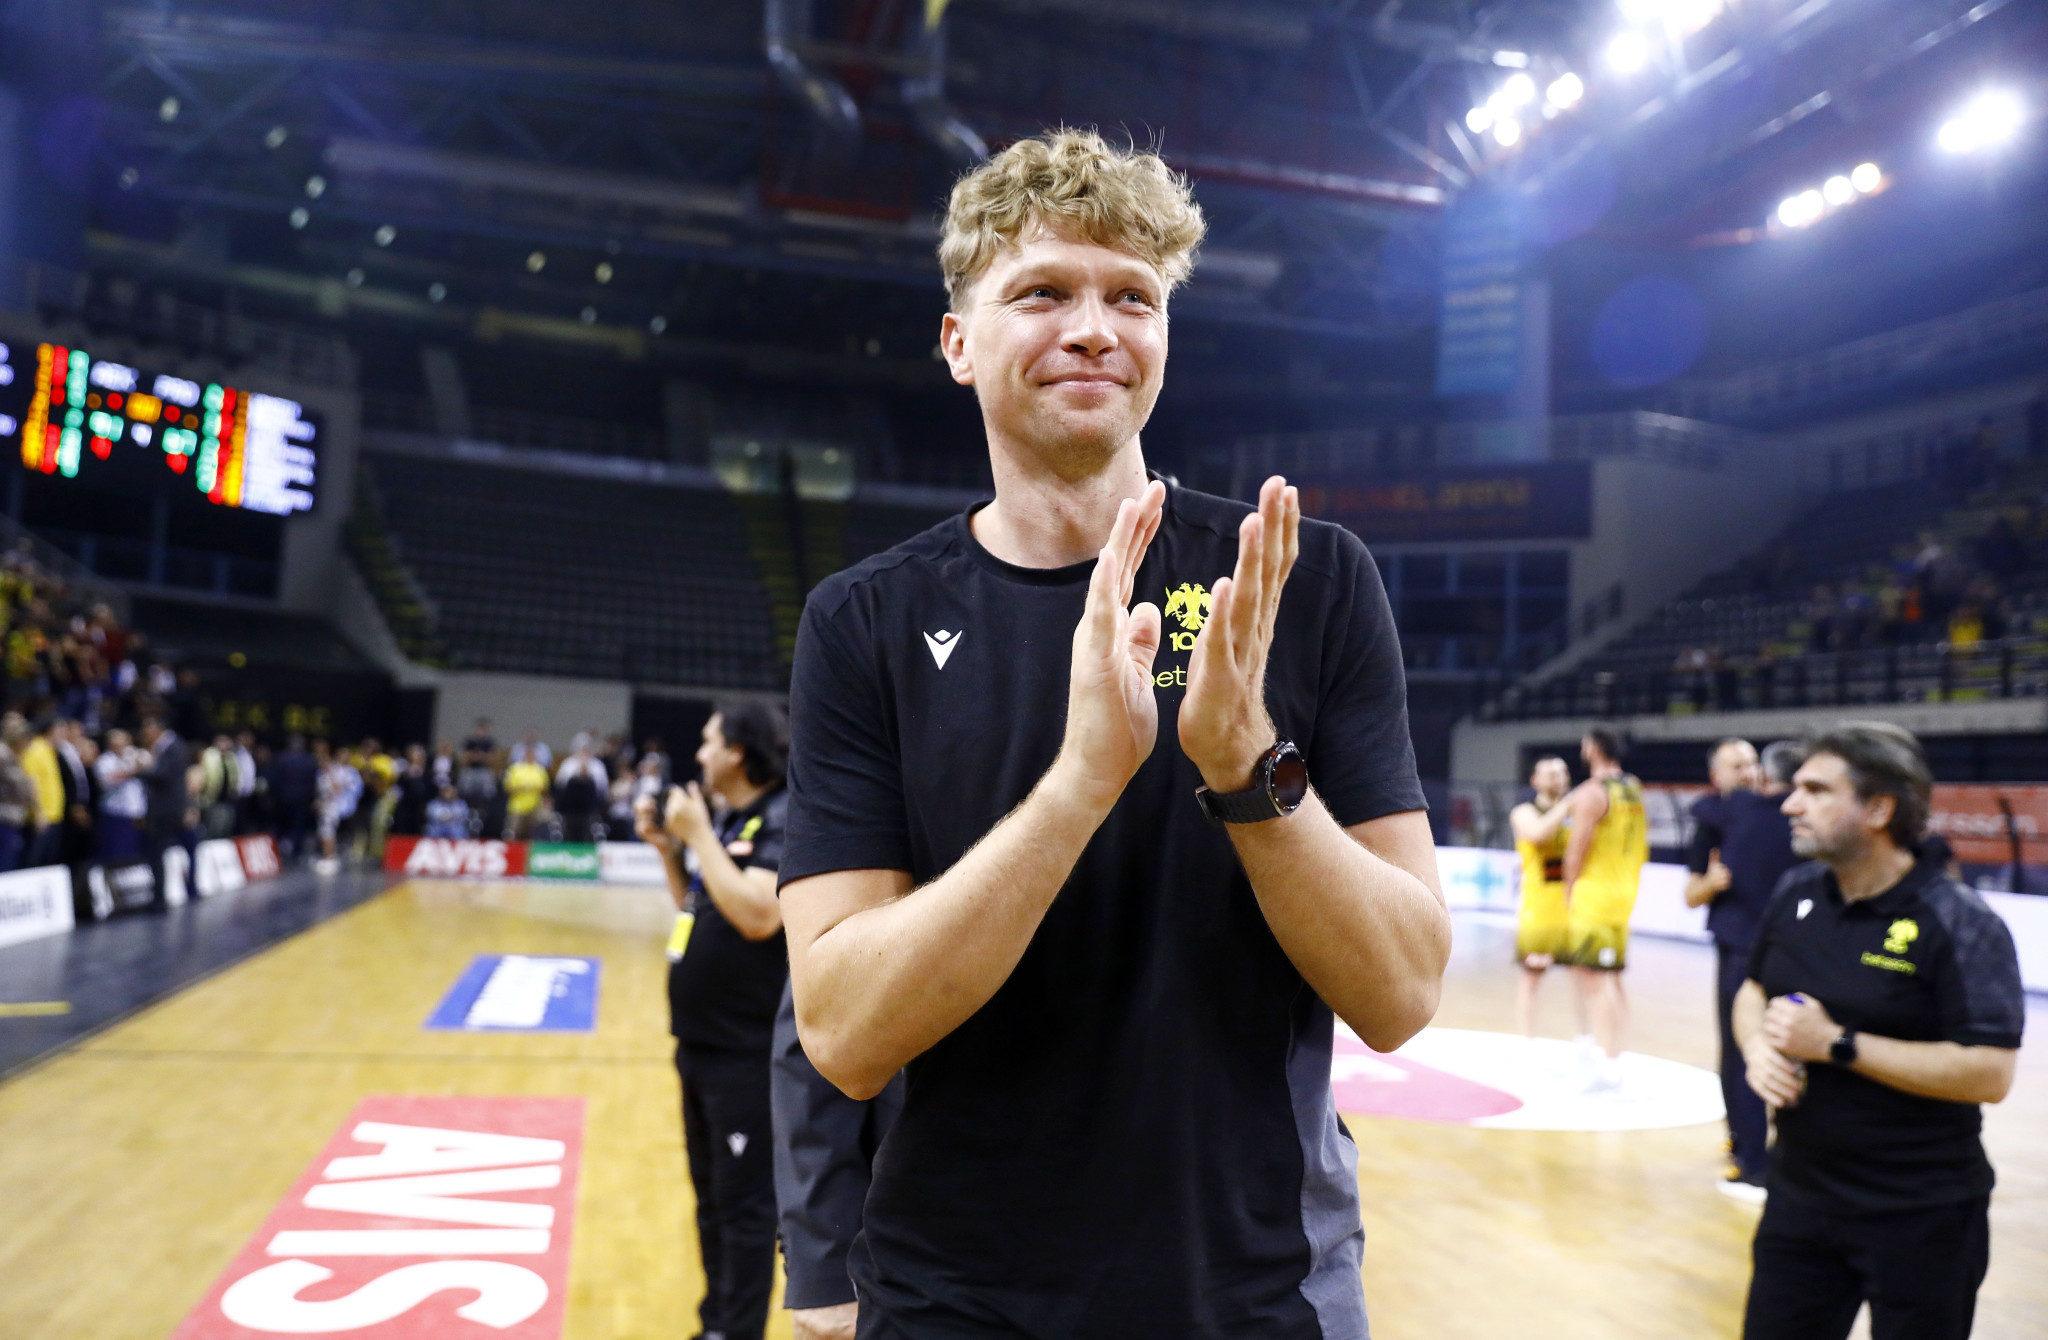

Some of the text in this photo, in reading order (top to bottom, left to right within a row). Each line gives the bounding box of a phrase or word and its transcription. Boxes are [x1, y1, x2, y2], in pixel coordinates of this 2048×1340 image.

[1151, 664, 1187, 688] et
[404, 838, 509, 876] AVIS
[220, 1121, 566, 1333] AVIS
